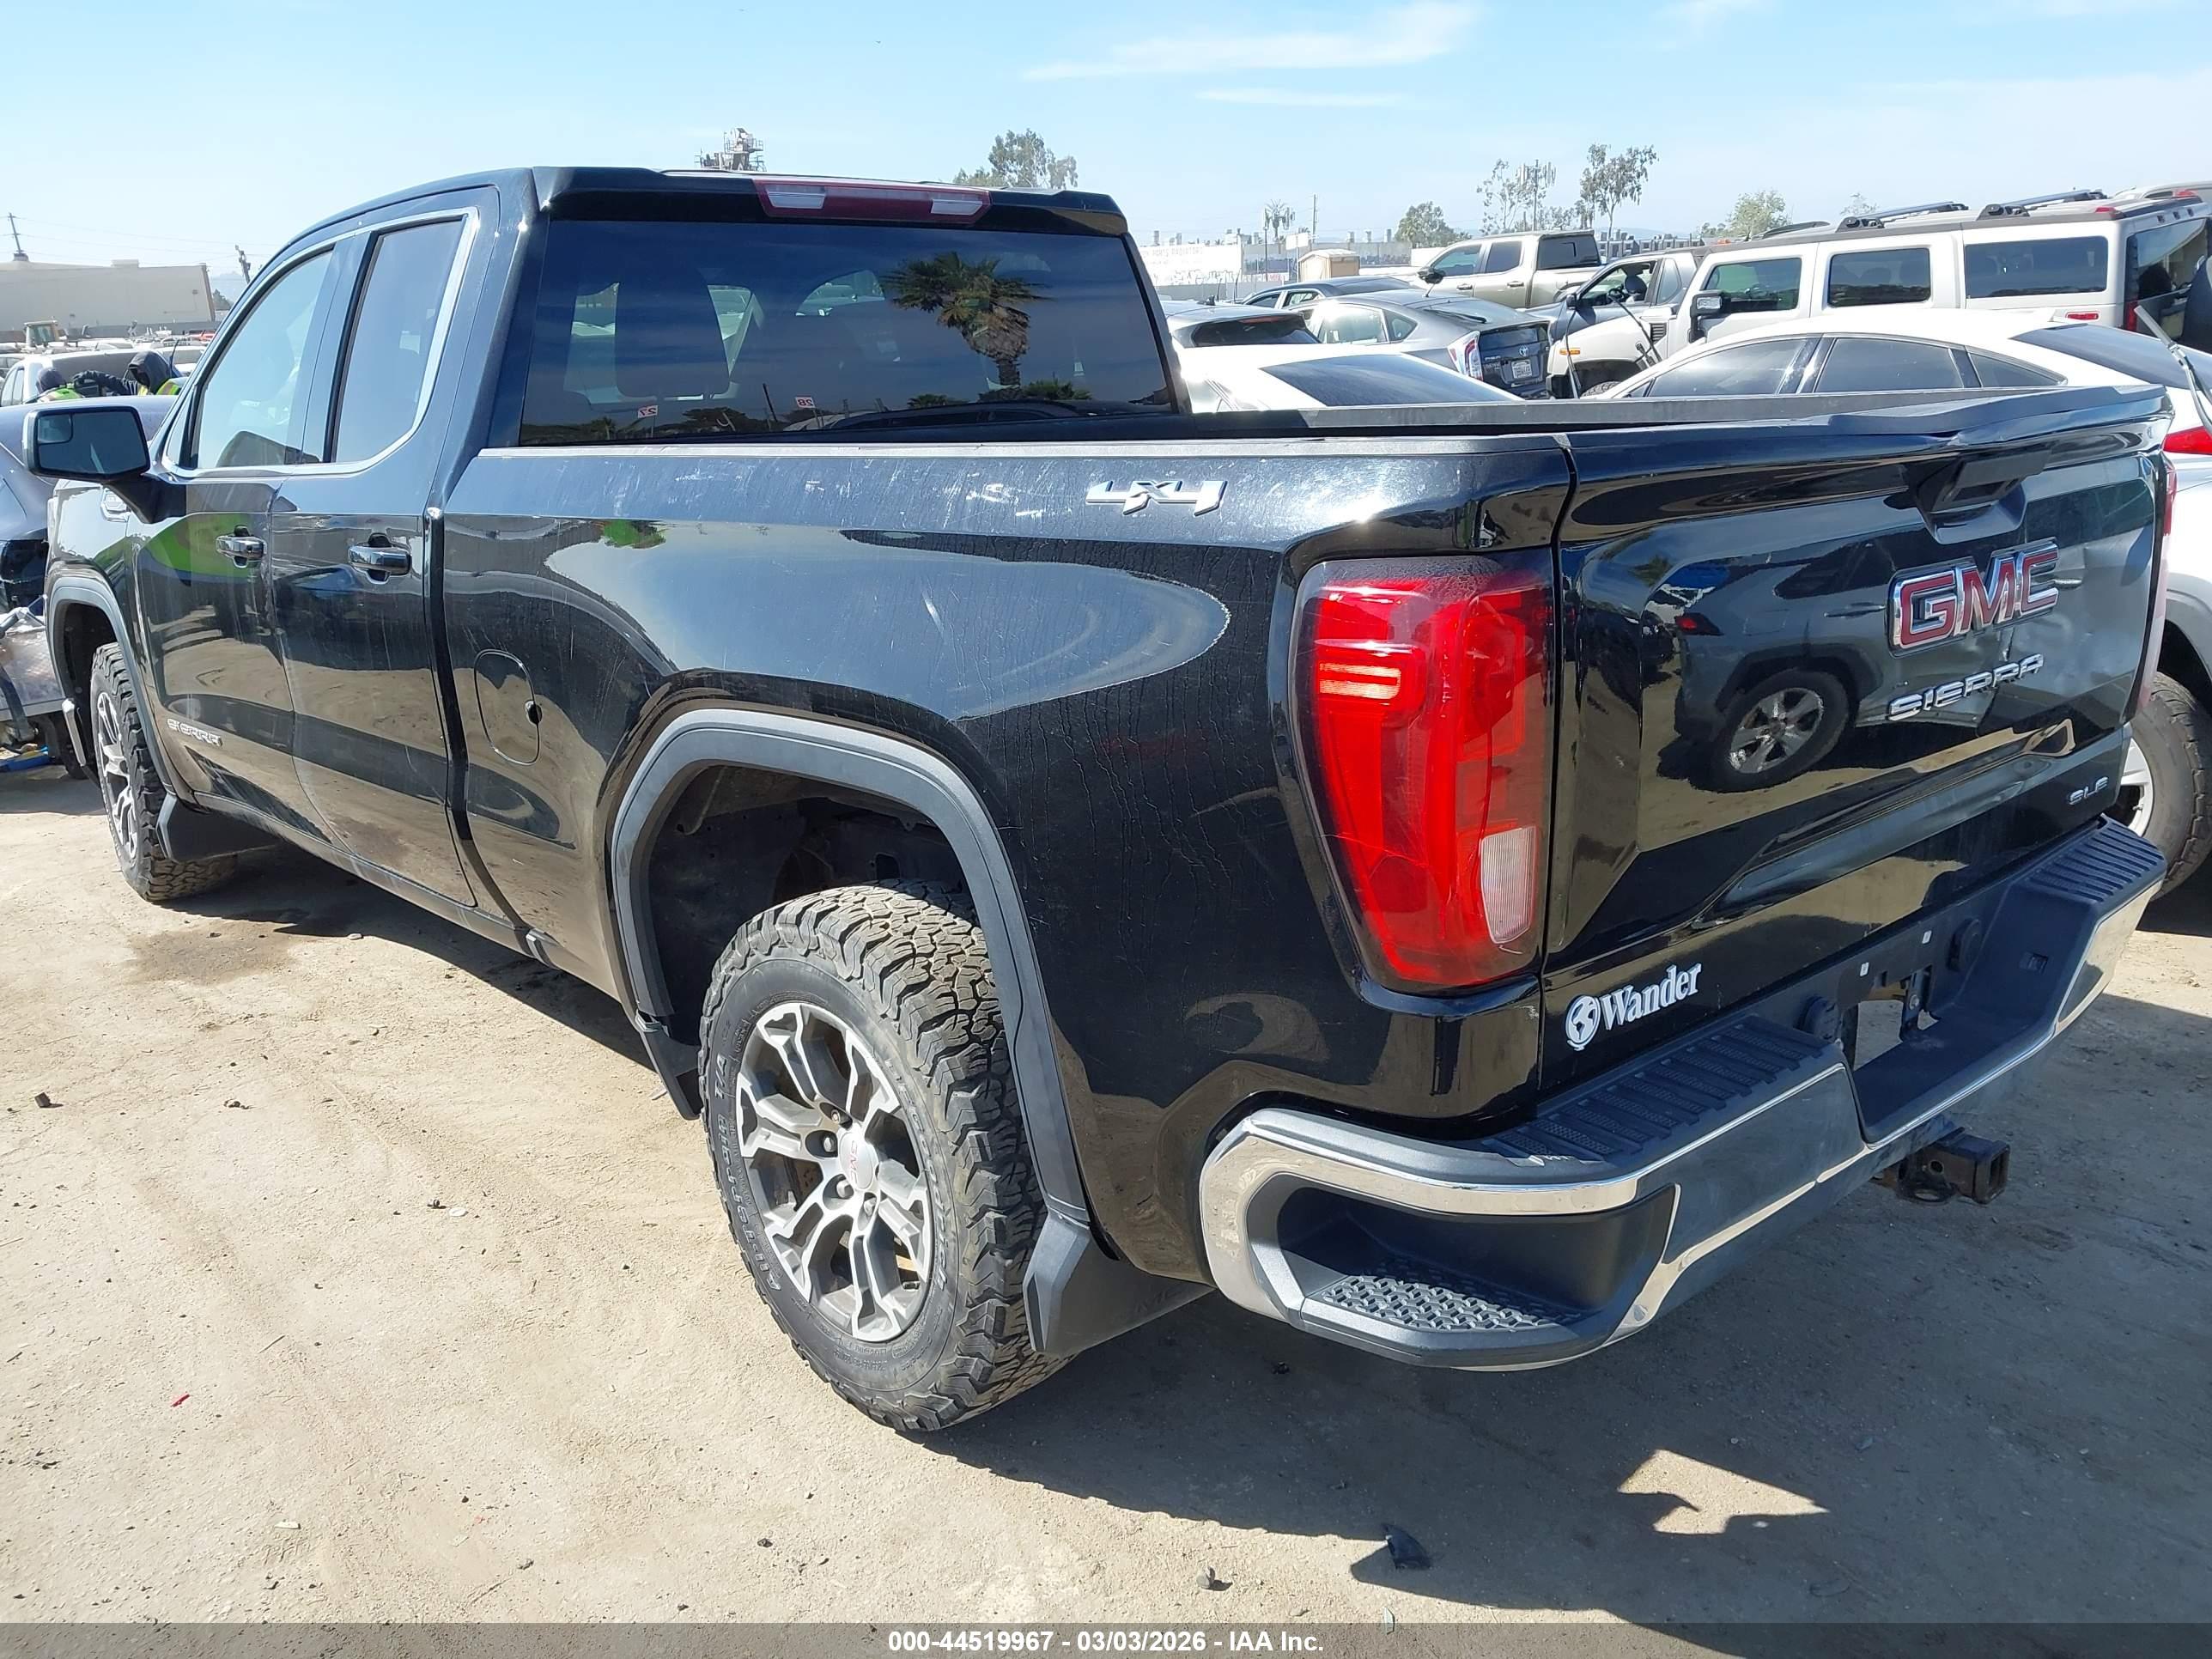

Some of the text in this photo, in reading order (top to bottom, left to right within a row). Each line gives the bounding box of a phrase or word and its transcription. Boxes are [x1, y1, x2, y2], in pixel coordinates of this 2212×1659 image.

[1892, 543, 2059, 649] GMC
[1888, 653, 2044, 720] SIERRA
[167, 718, 223, 747] SIERRA
[1599, 963, 1702, 1030] Wander
